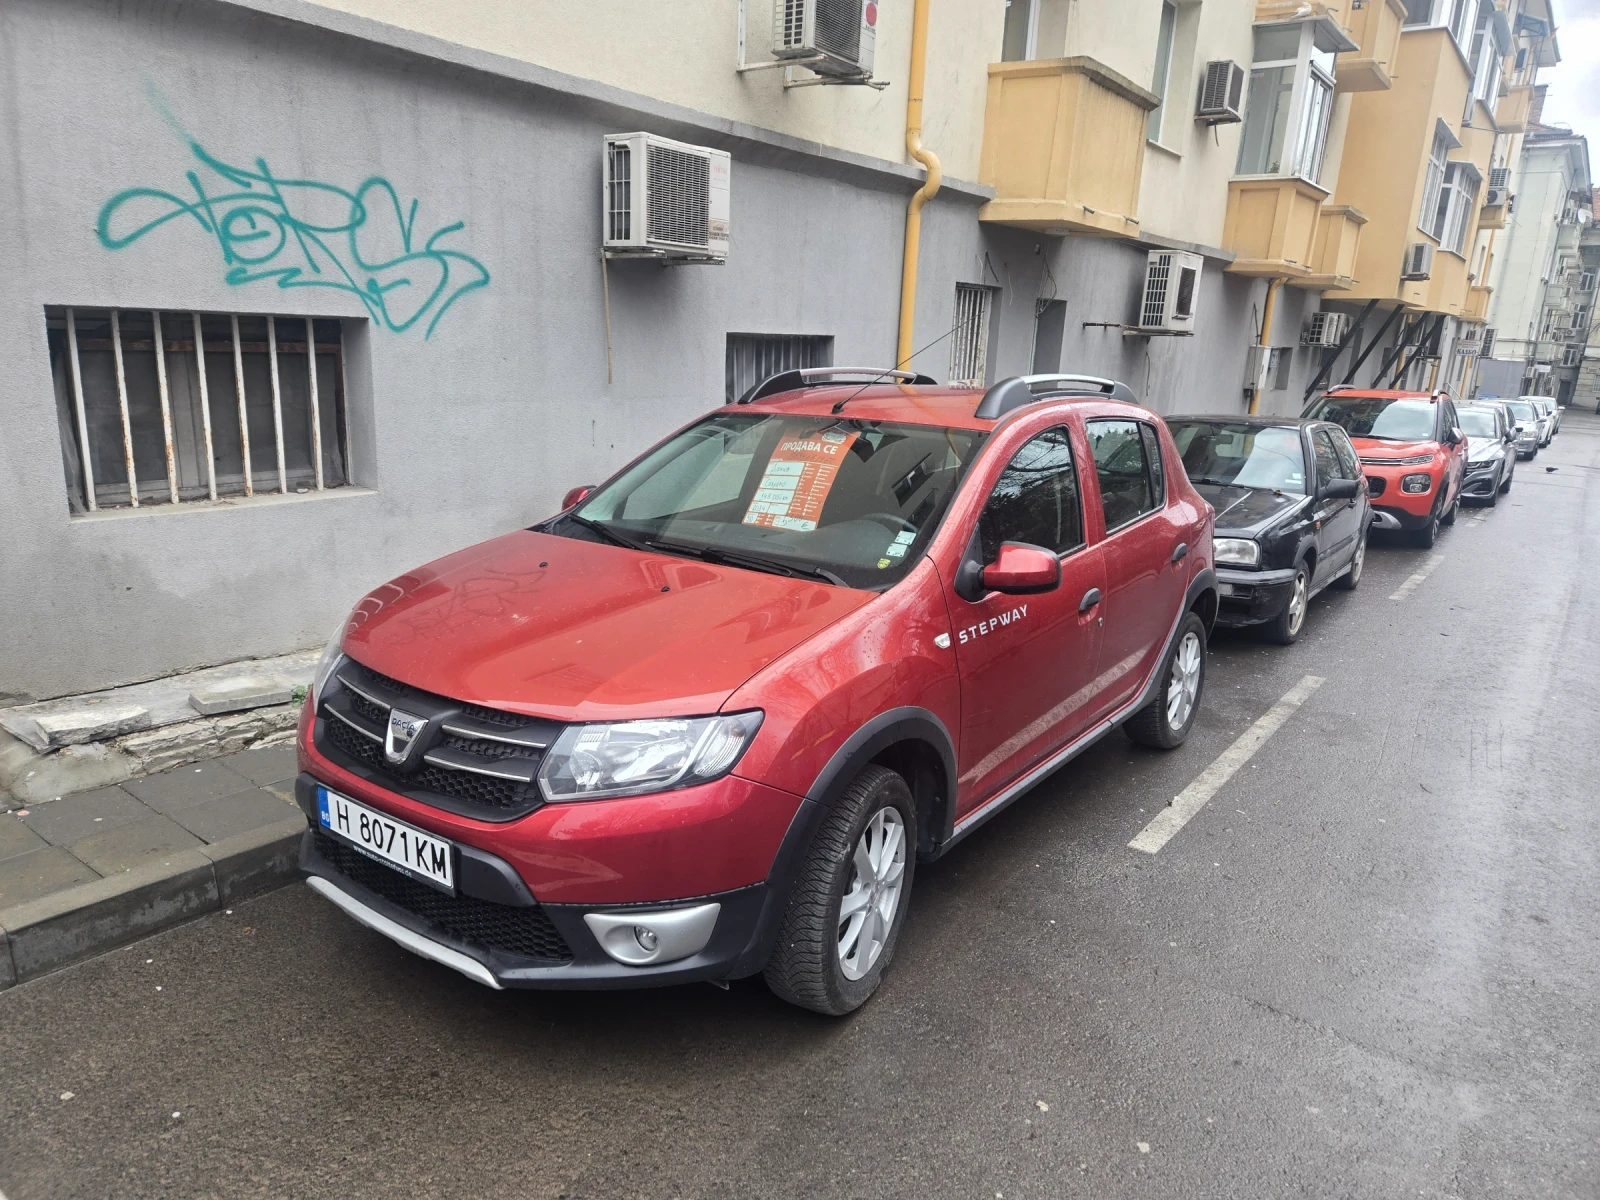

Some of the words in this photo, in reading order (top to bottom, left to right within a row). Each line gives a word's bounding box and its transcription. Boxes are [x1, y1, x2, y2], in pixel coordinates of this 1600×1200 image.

[780, 441, 821, 453] ПРОДАВА
[823, 445, 838, 455] СЕ
[958, 604, 1028, 645] STEPWAY
[391, 717, 415, 732] DACIA
[321, 810, 330, 823] BG
[336, 799, 350, 834] H
